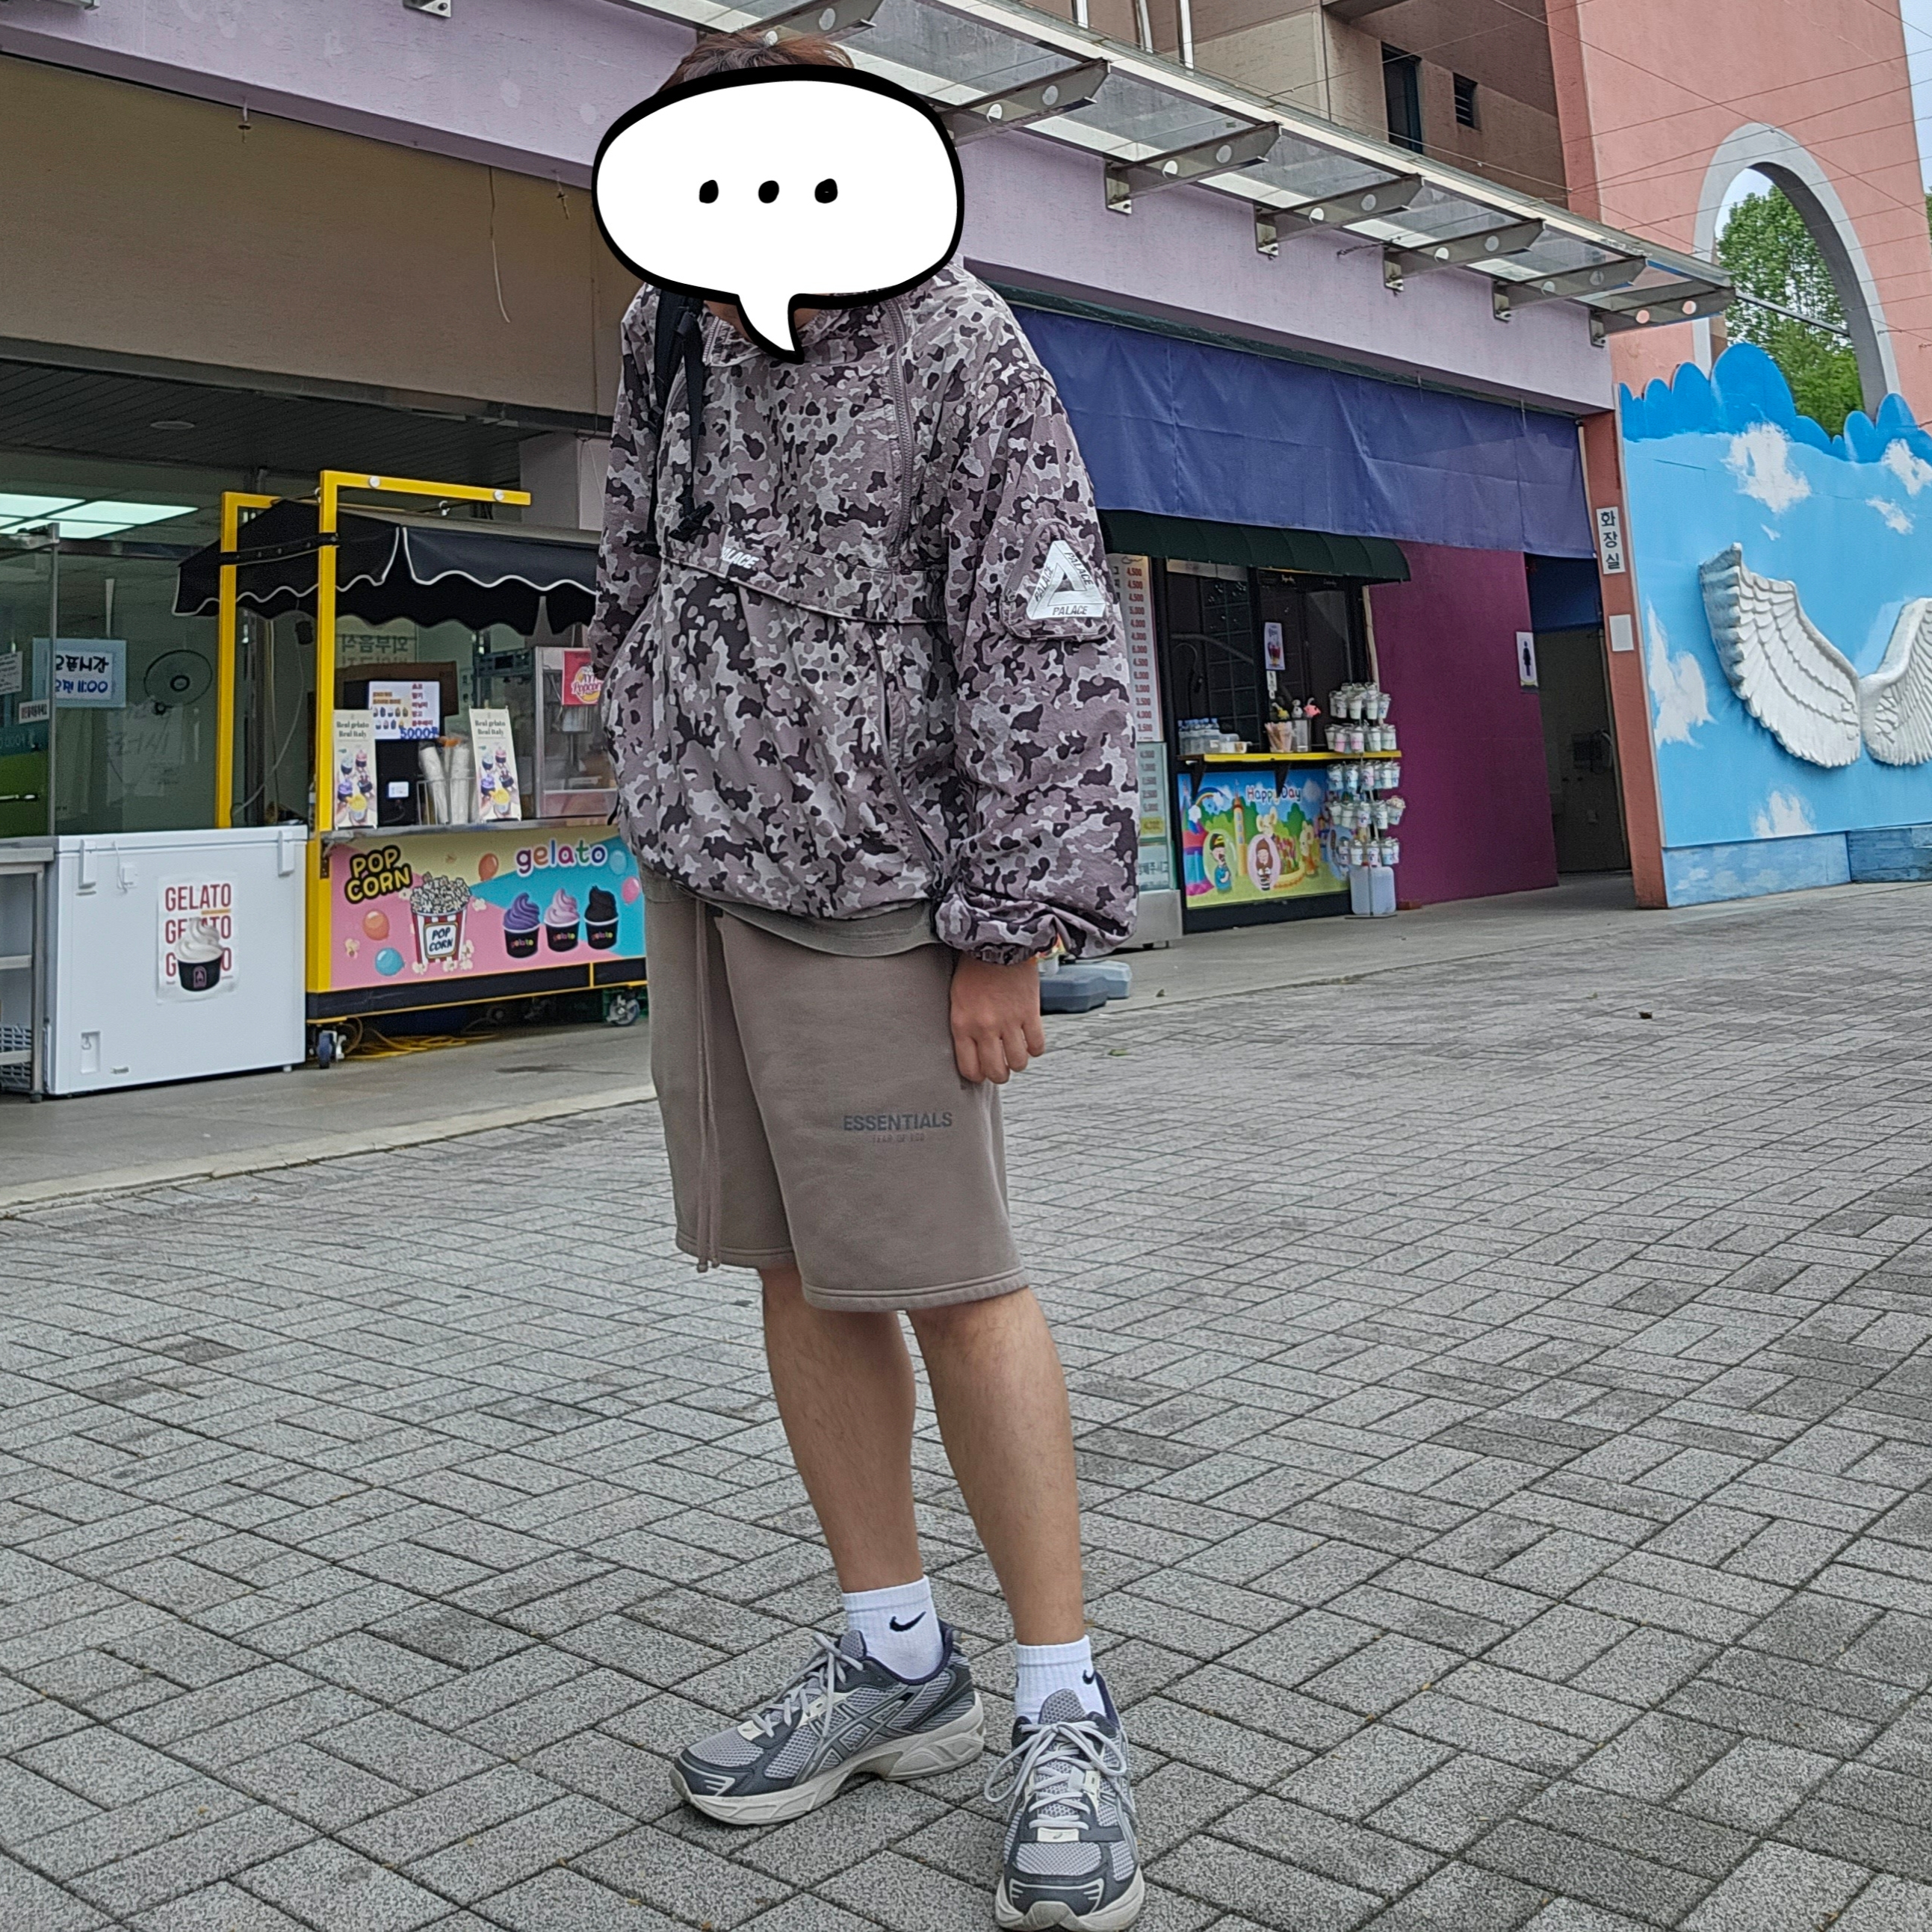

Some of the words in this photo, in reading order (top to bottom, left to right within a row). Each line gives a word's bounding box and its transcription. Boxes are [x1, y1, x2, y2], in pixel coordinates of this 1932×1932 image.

[1600, 510, 1620, 569] 화장실
[1064, 551, 1094, 586] PALACE
[1034, 564, 1054, 602] PALACE
[1052, 605, 1089, 616] PALACE
[78, 679, 109, 693] 11:00
[573, 681, 602, 694] Popcor
[1281, 785, 1301, 802] Day
[352, 848, 398, 879] POP
[516, 840, 606, 874] gelato
[347, 867, 410, 901] CORN
[165, 883, 232, 911] GELATO
[429, 938, 453, 952] CORN
[432, 926, 451, 941] POP
[843, 1112, 953, 1131] ESSENTIALS
